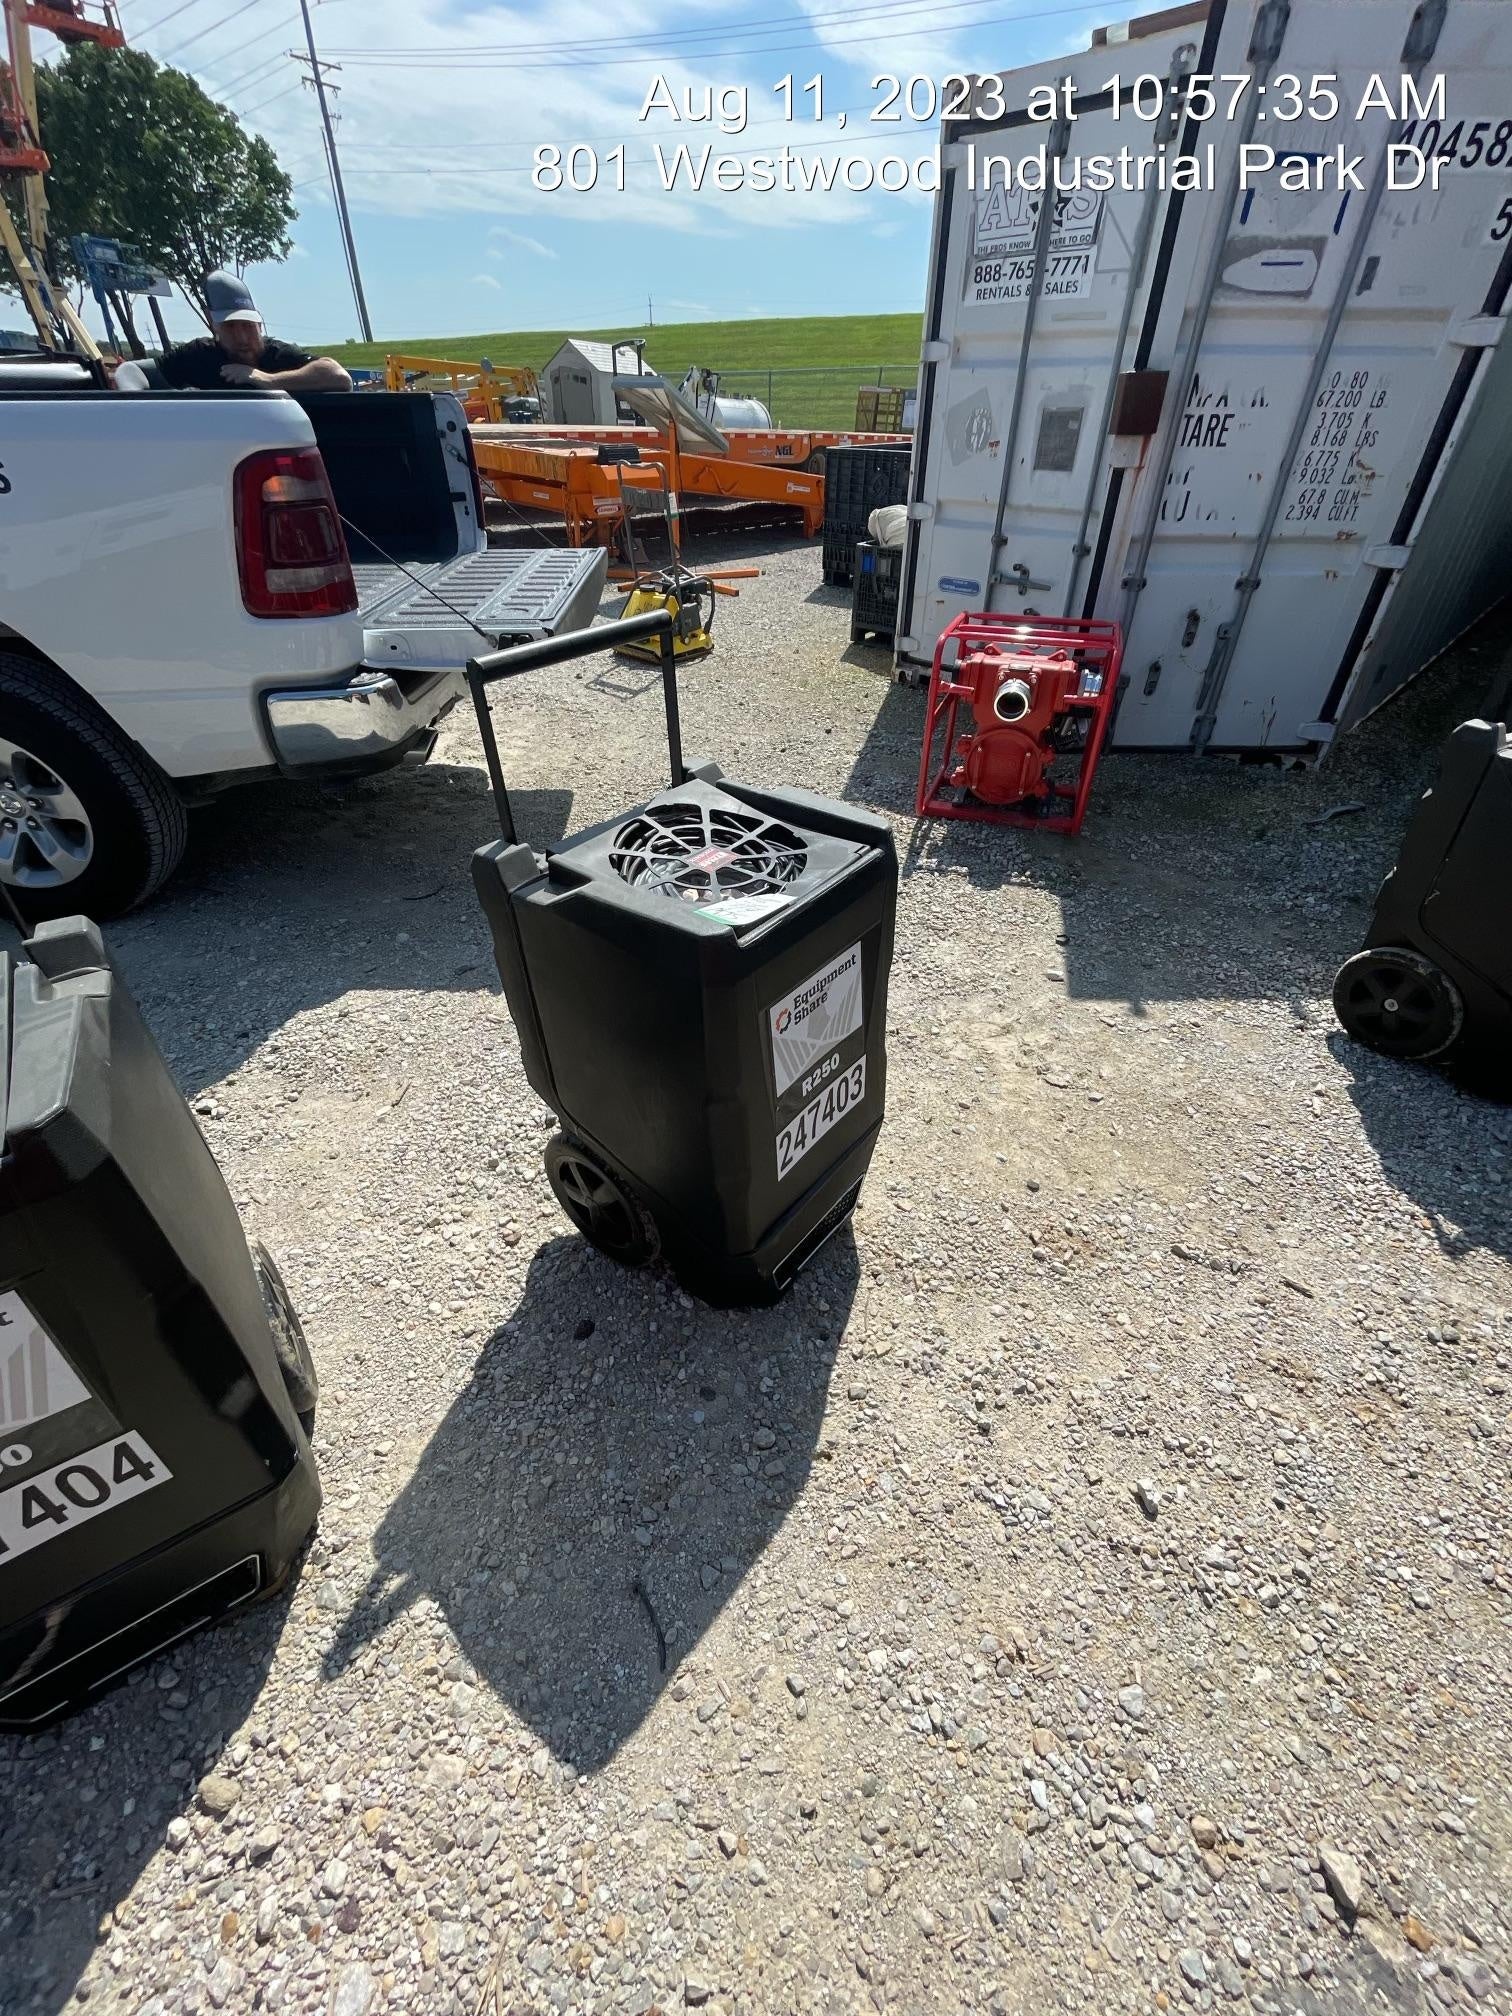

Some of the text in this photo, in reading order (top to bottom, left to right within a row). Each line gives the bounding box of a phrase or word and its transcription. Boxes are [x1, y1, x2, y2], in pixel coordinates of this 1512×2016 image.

[1397, 120, 1512, 168] 40458
[1008, 240, 1031, 250] KNOW
[1067, 235, 1078, 244] TO
[1079, 234, 1092, 243] GO
[976, 284, 1022, 300] RENTALS
[1045, 280, 1079, 295] SALES
[1181, 413, 1235, 447] TARE
[793, 954, 857, 1010] Equipment
[794, 989, 828, 1026] Share
[802, 1052, 840, 1096] R250
[780, 1063, 863, 1174] 247403
[0, 1441, 155, 1556] 404
